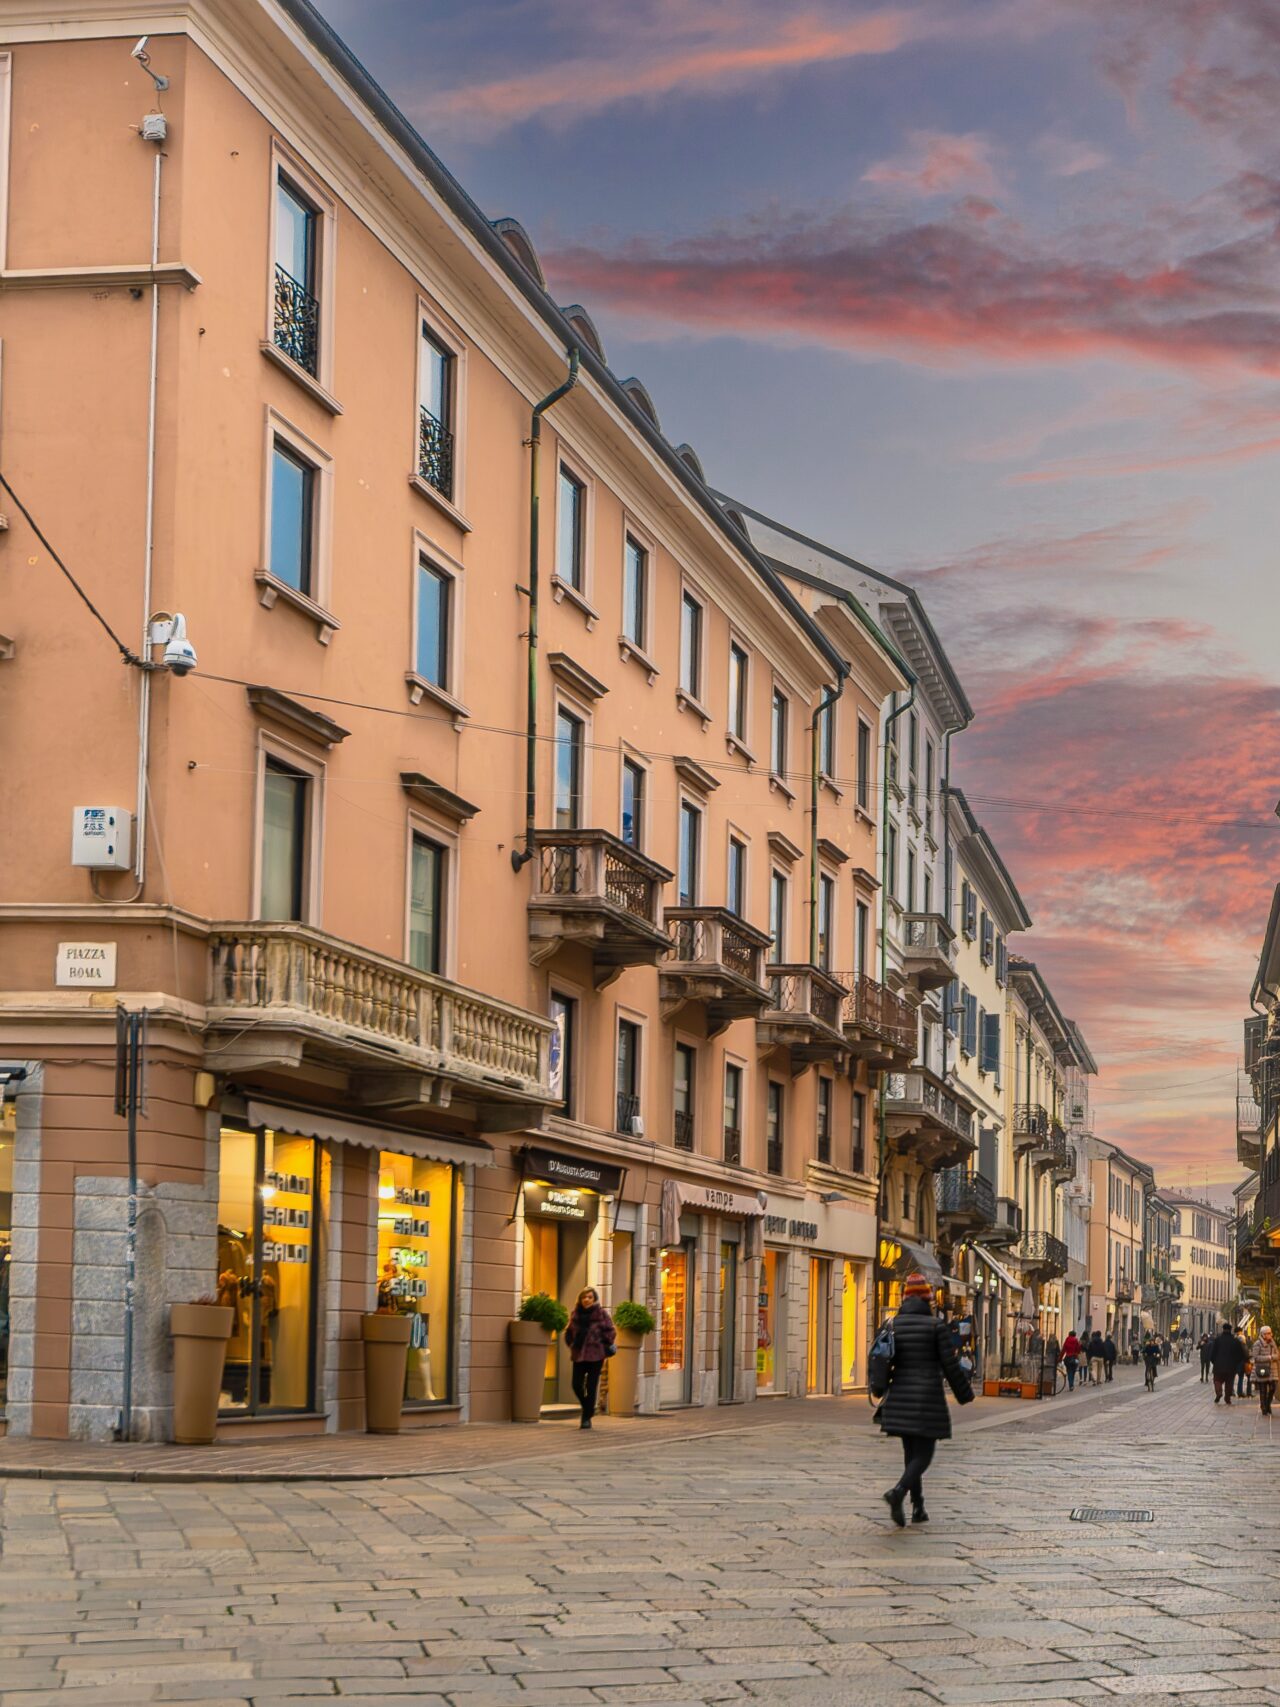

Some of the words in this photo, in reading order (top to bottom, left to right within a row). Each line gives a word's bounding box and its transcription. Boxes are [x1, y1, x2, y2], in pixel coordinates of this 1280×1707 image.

[66, 948, 106, 960] PIAZZA
[69, 967, 102, 979] ROMA
[705, 1189, 734, 1207] vampe
